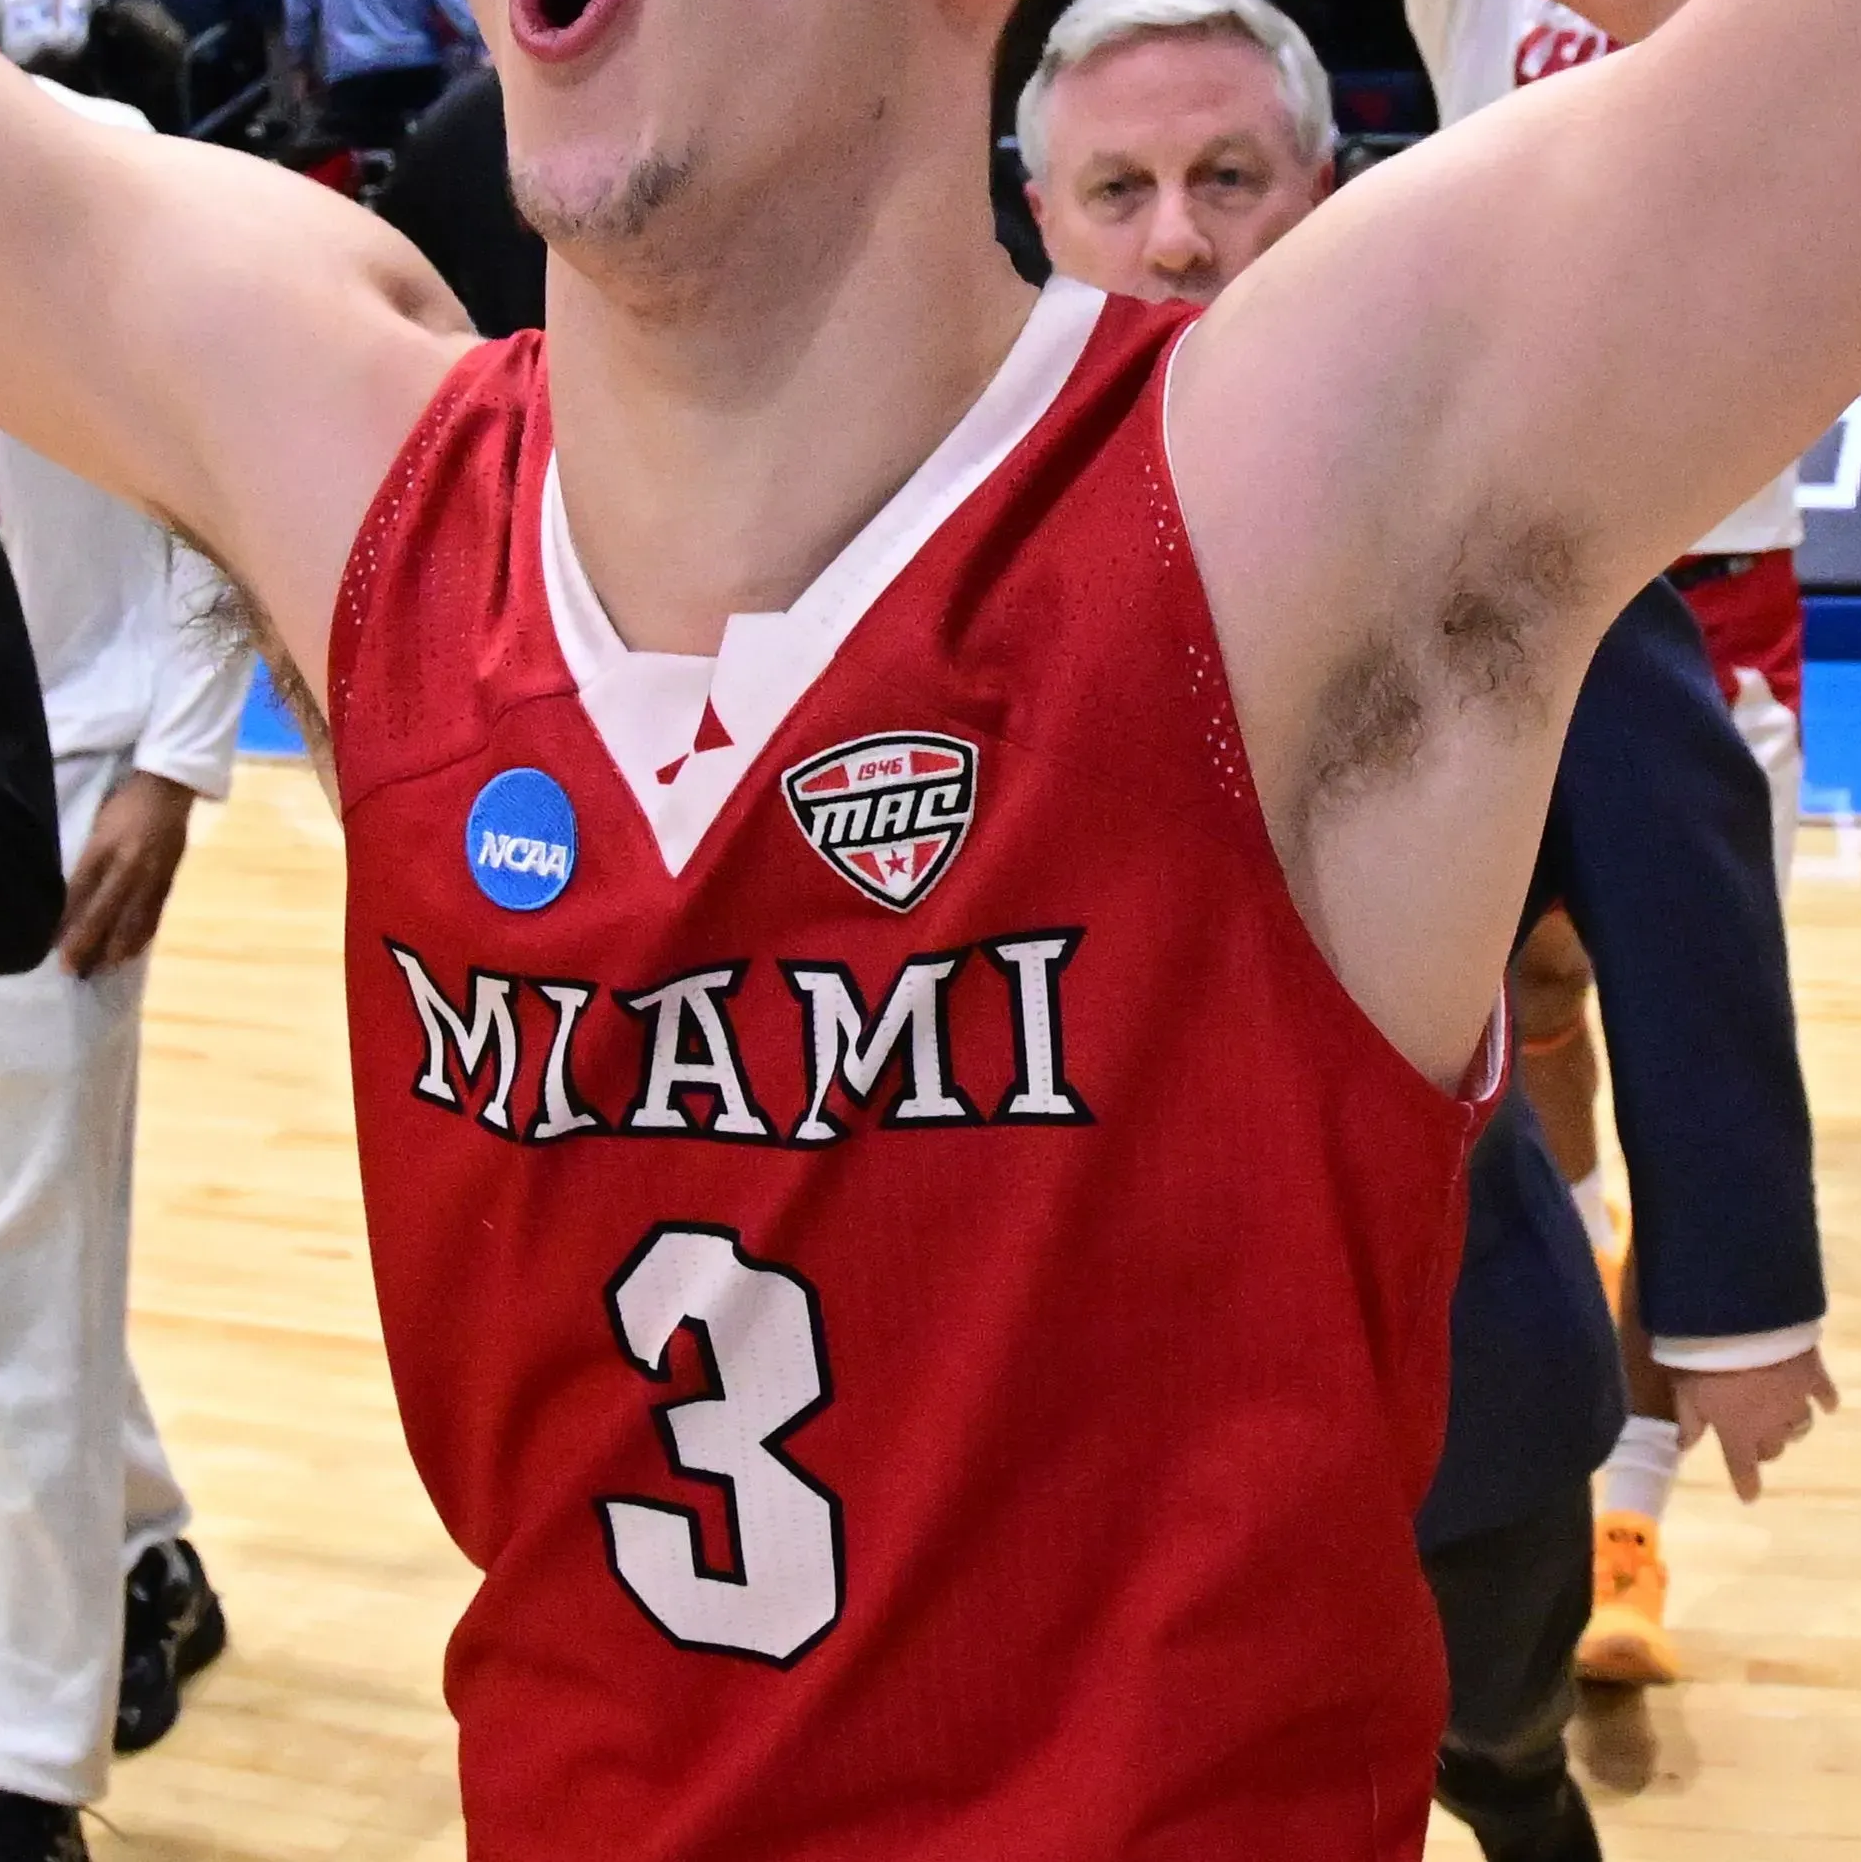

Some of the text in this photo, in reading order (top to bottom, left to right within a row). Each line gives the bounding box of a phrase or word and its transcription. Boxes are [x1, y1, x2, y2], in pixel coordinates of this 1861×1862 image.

[857, 757, 904, 782] 1946
[810, 783, 970, 849] MAC
[478, 831, 568, 879] NCAA
[386, 932, 1088, 1144] MIAMI
[600, 1226, 842, 1666] 3
